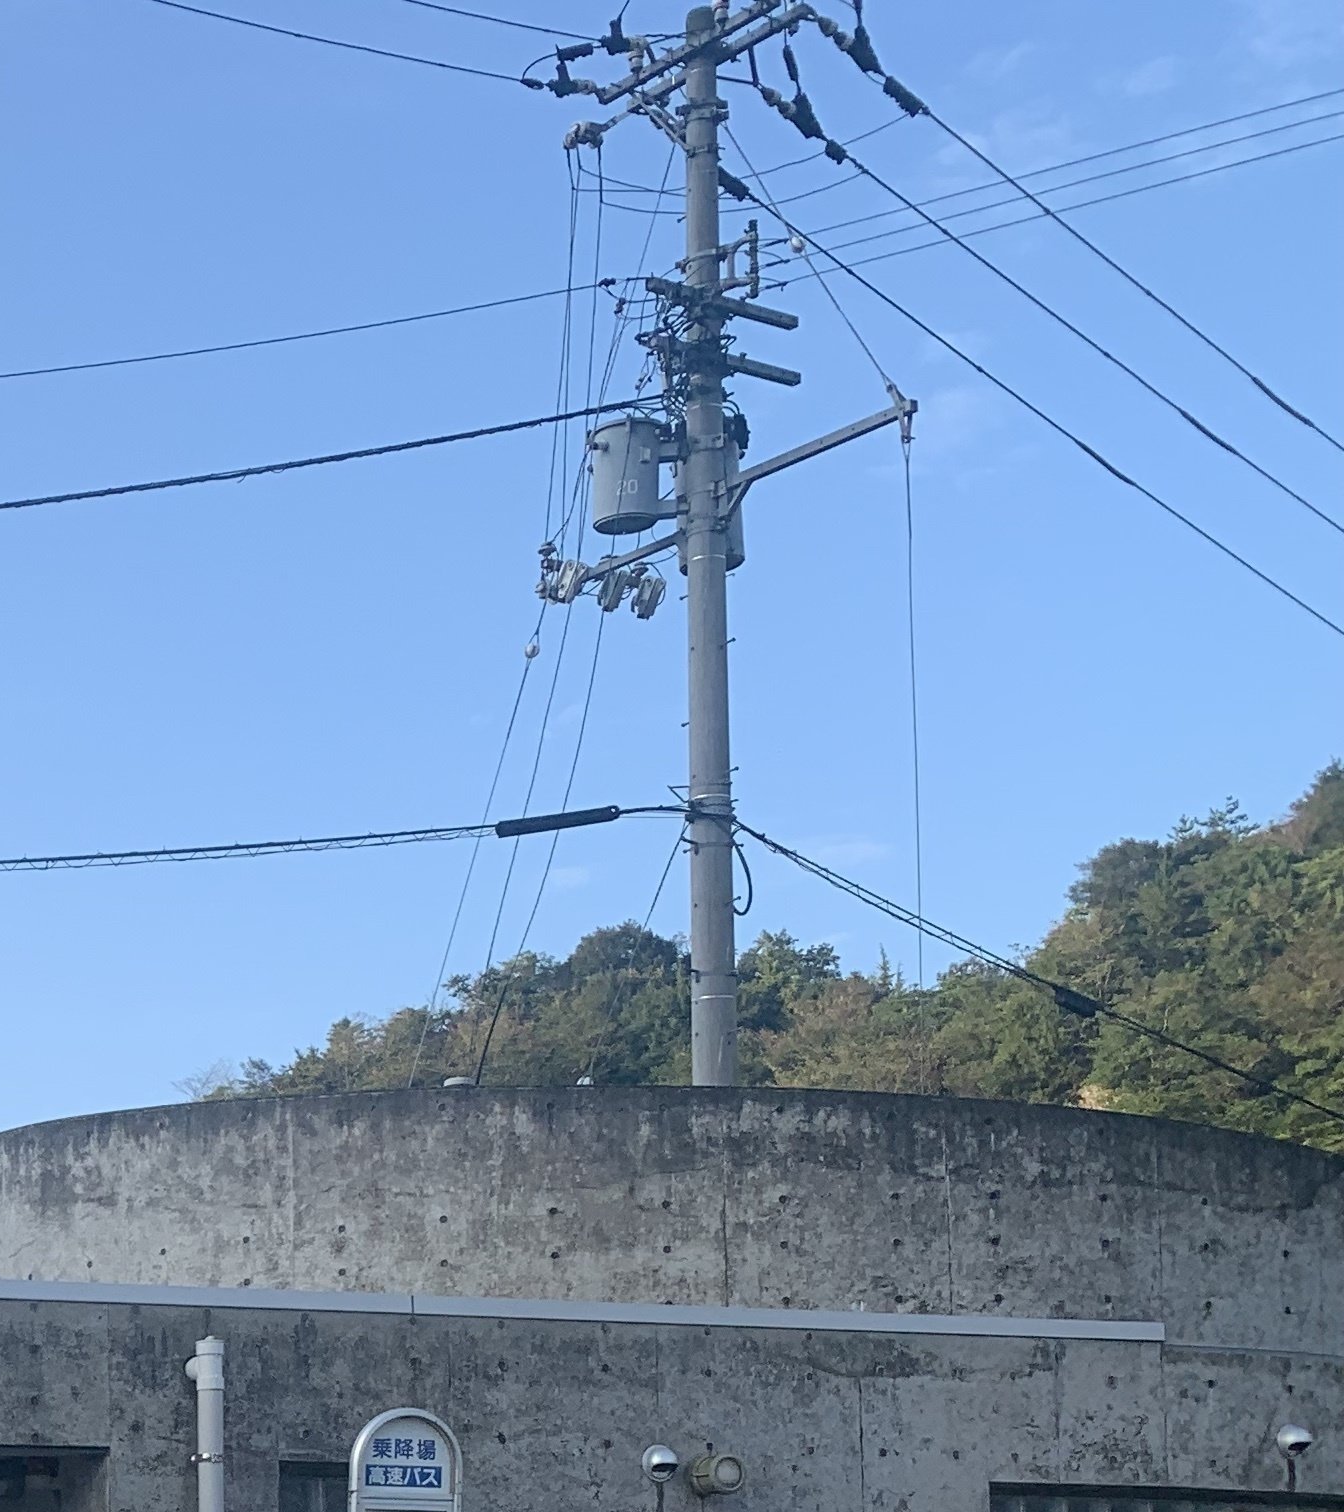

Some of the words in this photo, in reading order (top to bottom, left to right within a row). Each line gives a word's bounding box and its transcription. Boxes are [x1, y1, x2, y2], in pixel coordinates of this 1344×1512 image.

[616, 479, 639, 497] 20
[372, 1438, 436, 1461] 乗降場
[368, 1466, 439, 1486] 高速バス
